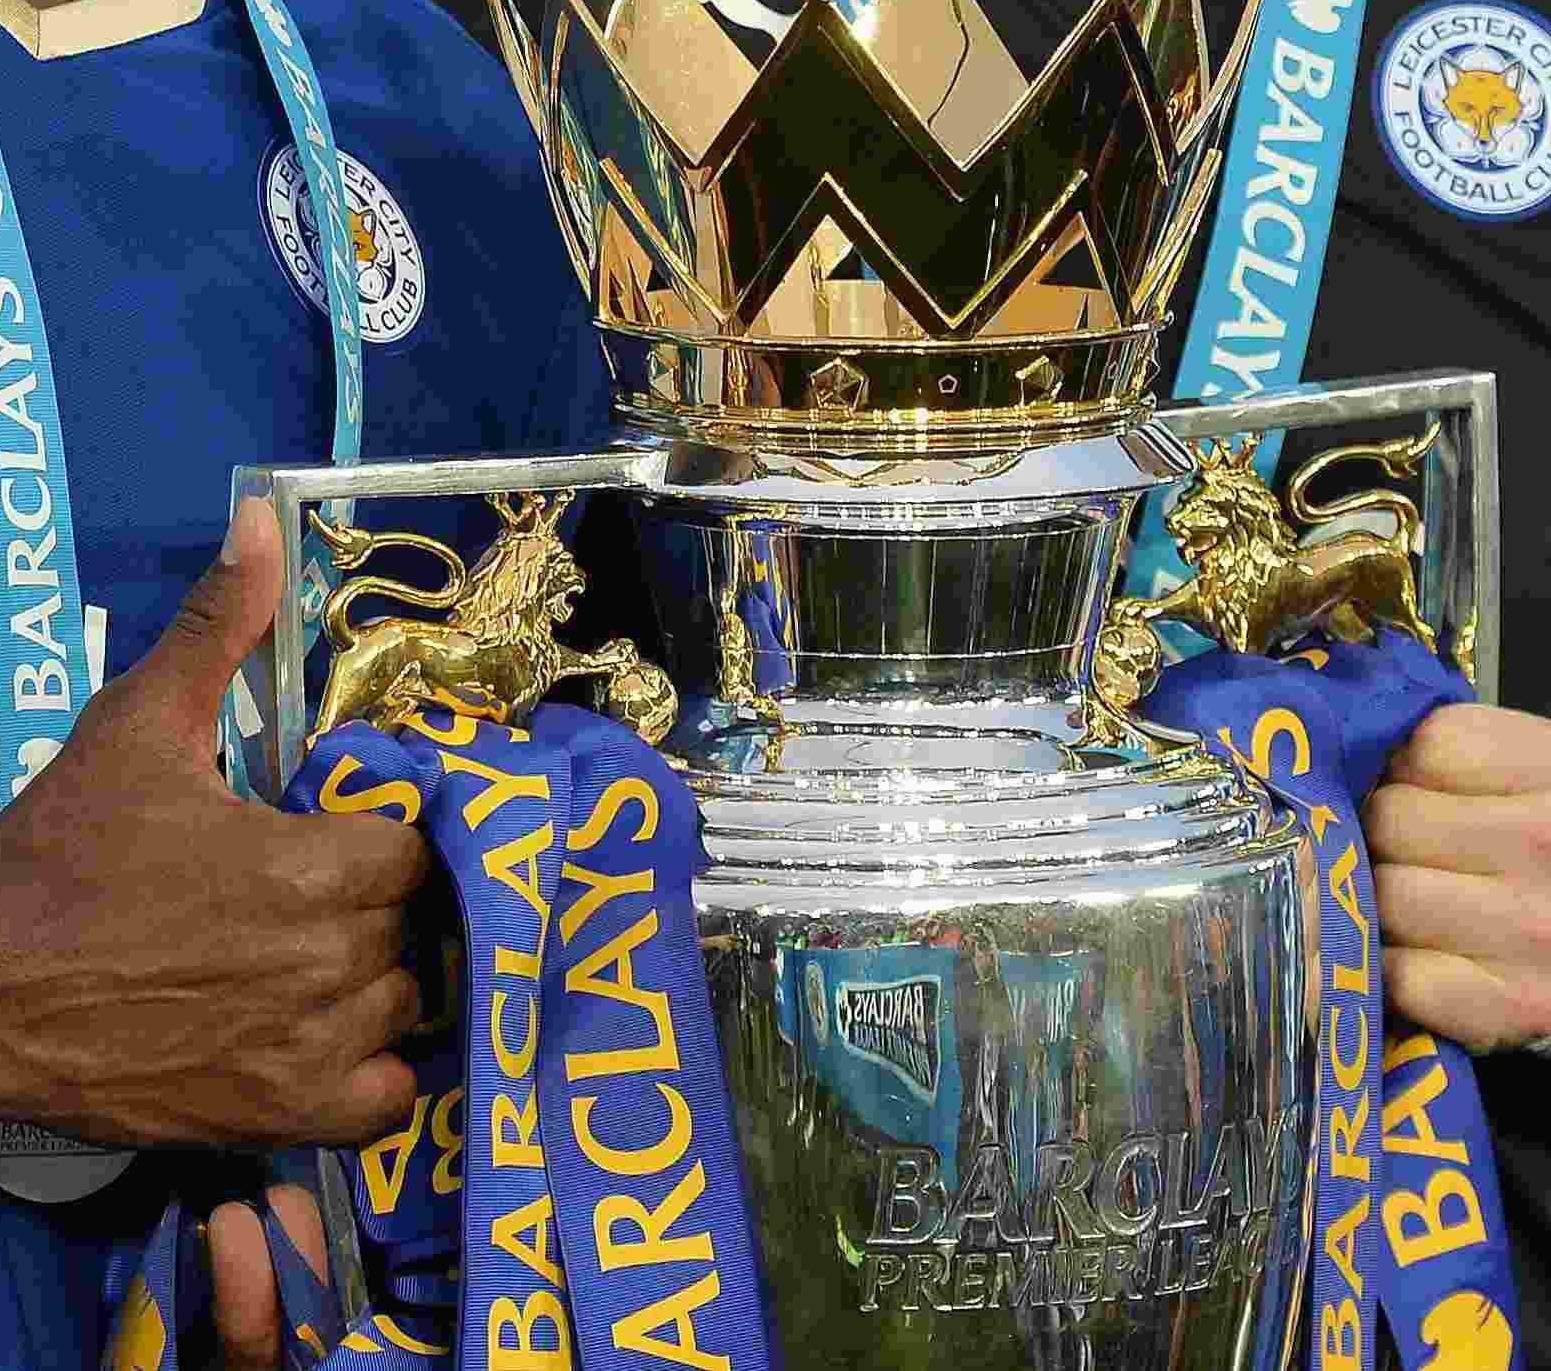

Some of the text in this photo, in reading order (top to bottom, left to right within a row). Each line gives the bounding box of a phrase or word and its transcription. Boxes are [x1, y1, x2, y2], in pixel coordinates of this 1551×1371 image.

[1393, 15, 1528, 92] LEICESTER
[1393, 111, 1525, 203] FOOTBALL
[379, 199, 416, 266] CITY
[1201, 39, 1335, 400] BARCLAY
[380, 279, 418, 330] CLUB
[559, 776, 732, 1371] ARCLAYS
[859, 1242, 1143, 1314] PREMIER
